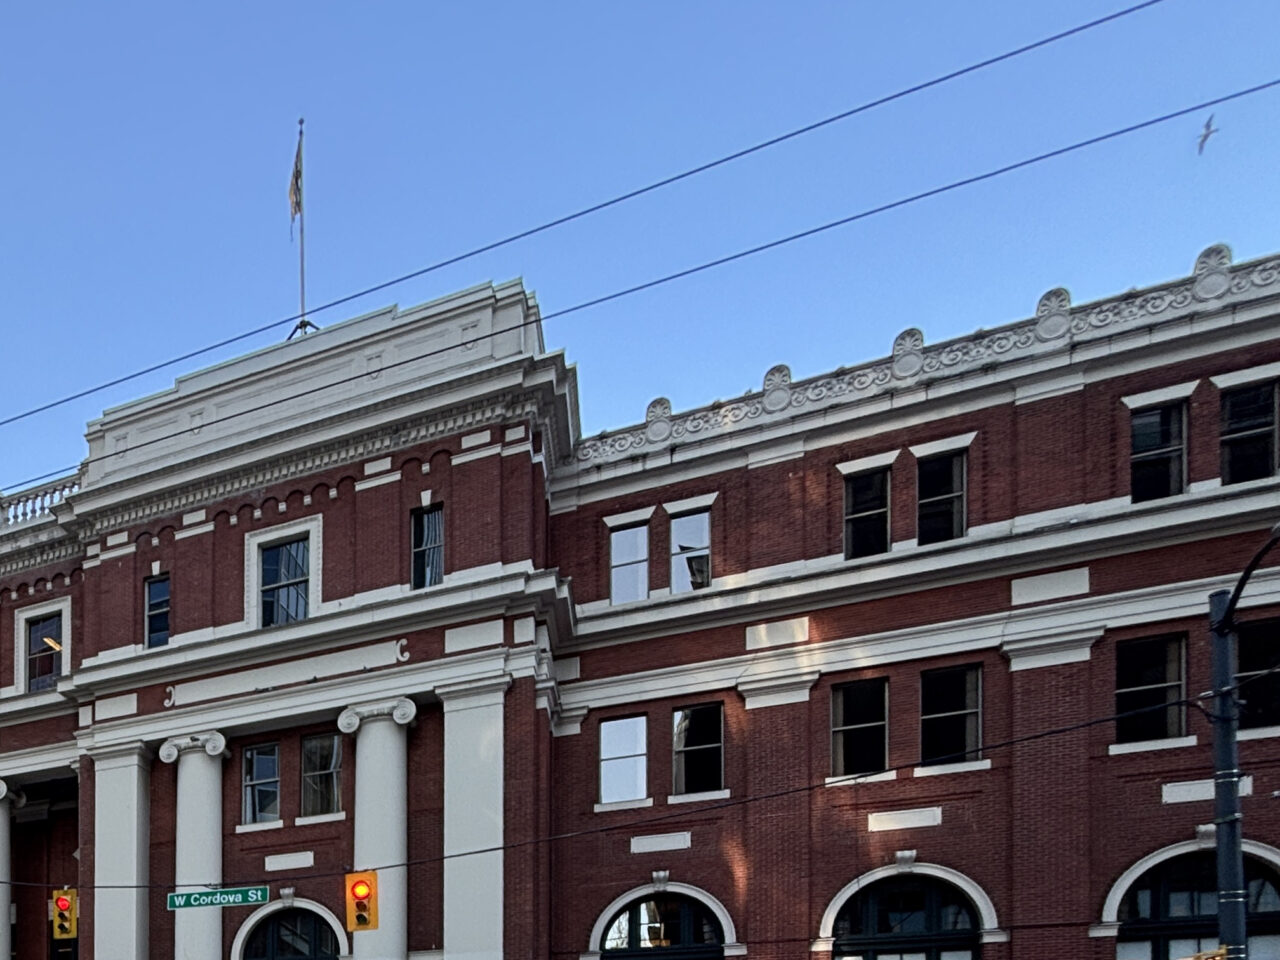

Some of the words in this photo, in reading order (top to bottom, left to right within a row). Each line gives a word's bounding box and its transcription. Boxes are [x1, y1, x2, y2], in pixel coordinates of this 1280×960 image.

[174, 895, 187, 907] W
[190, 893, 242, 906] Cordova
[248, 889, 263, 902] St
